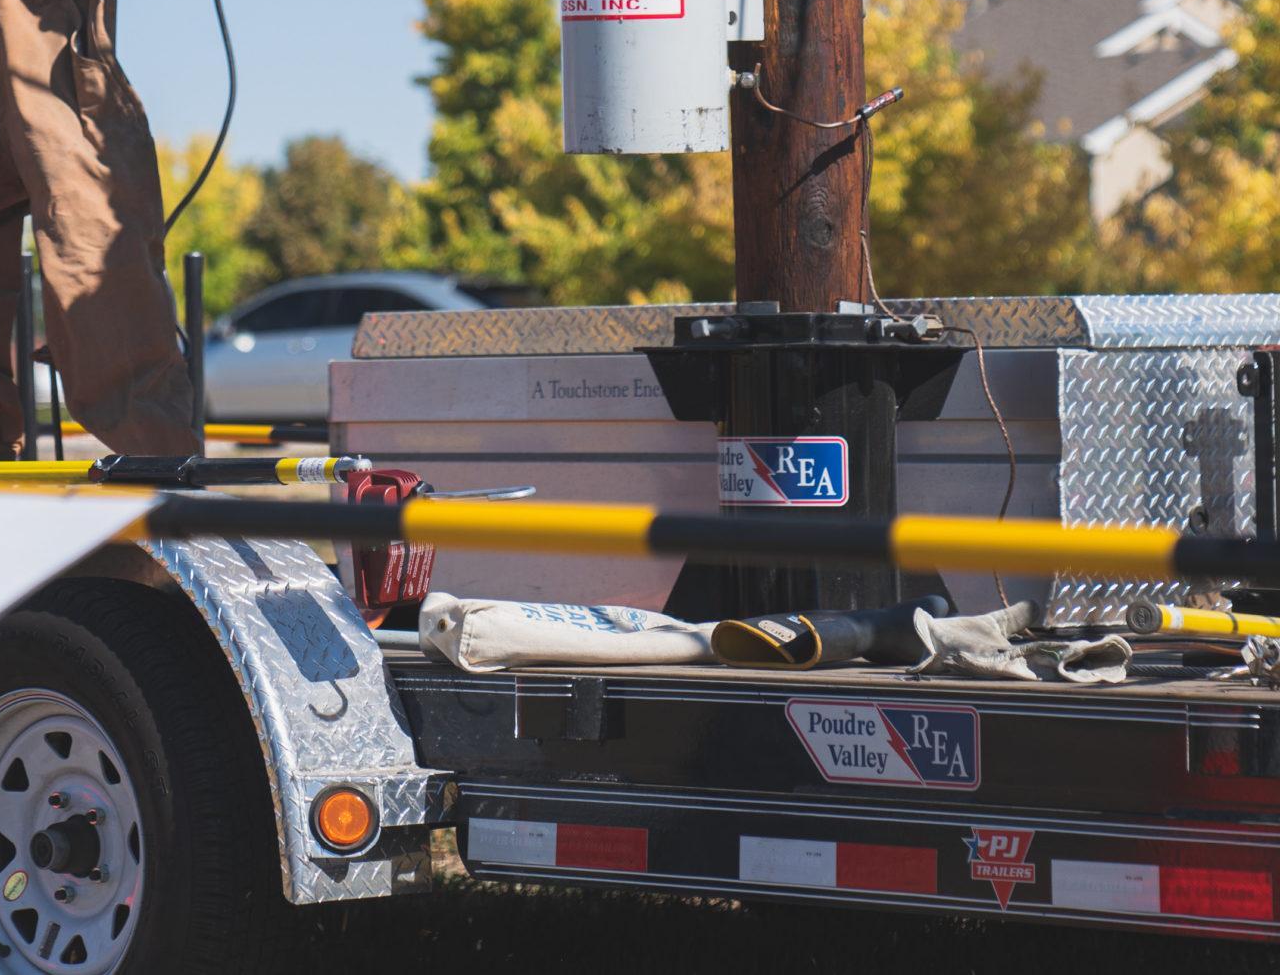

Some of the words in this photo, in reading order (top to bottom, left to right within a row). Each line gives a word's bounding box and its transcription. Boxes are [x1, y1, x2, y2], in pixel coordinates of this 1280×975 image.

[531, 381, 545, 399] A
[547, 378, 630, 399] Touchstone
[775, 445, 838, 496] REA
[808, 711, 876, 737] Poudre
[827, 743, 889, 774] Valley
[911, 713, 969, 778] REA
[988, 834, 1020, 858] PJ
[975, 864, 1033, 879] TRAILERS
